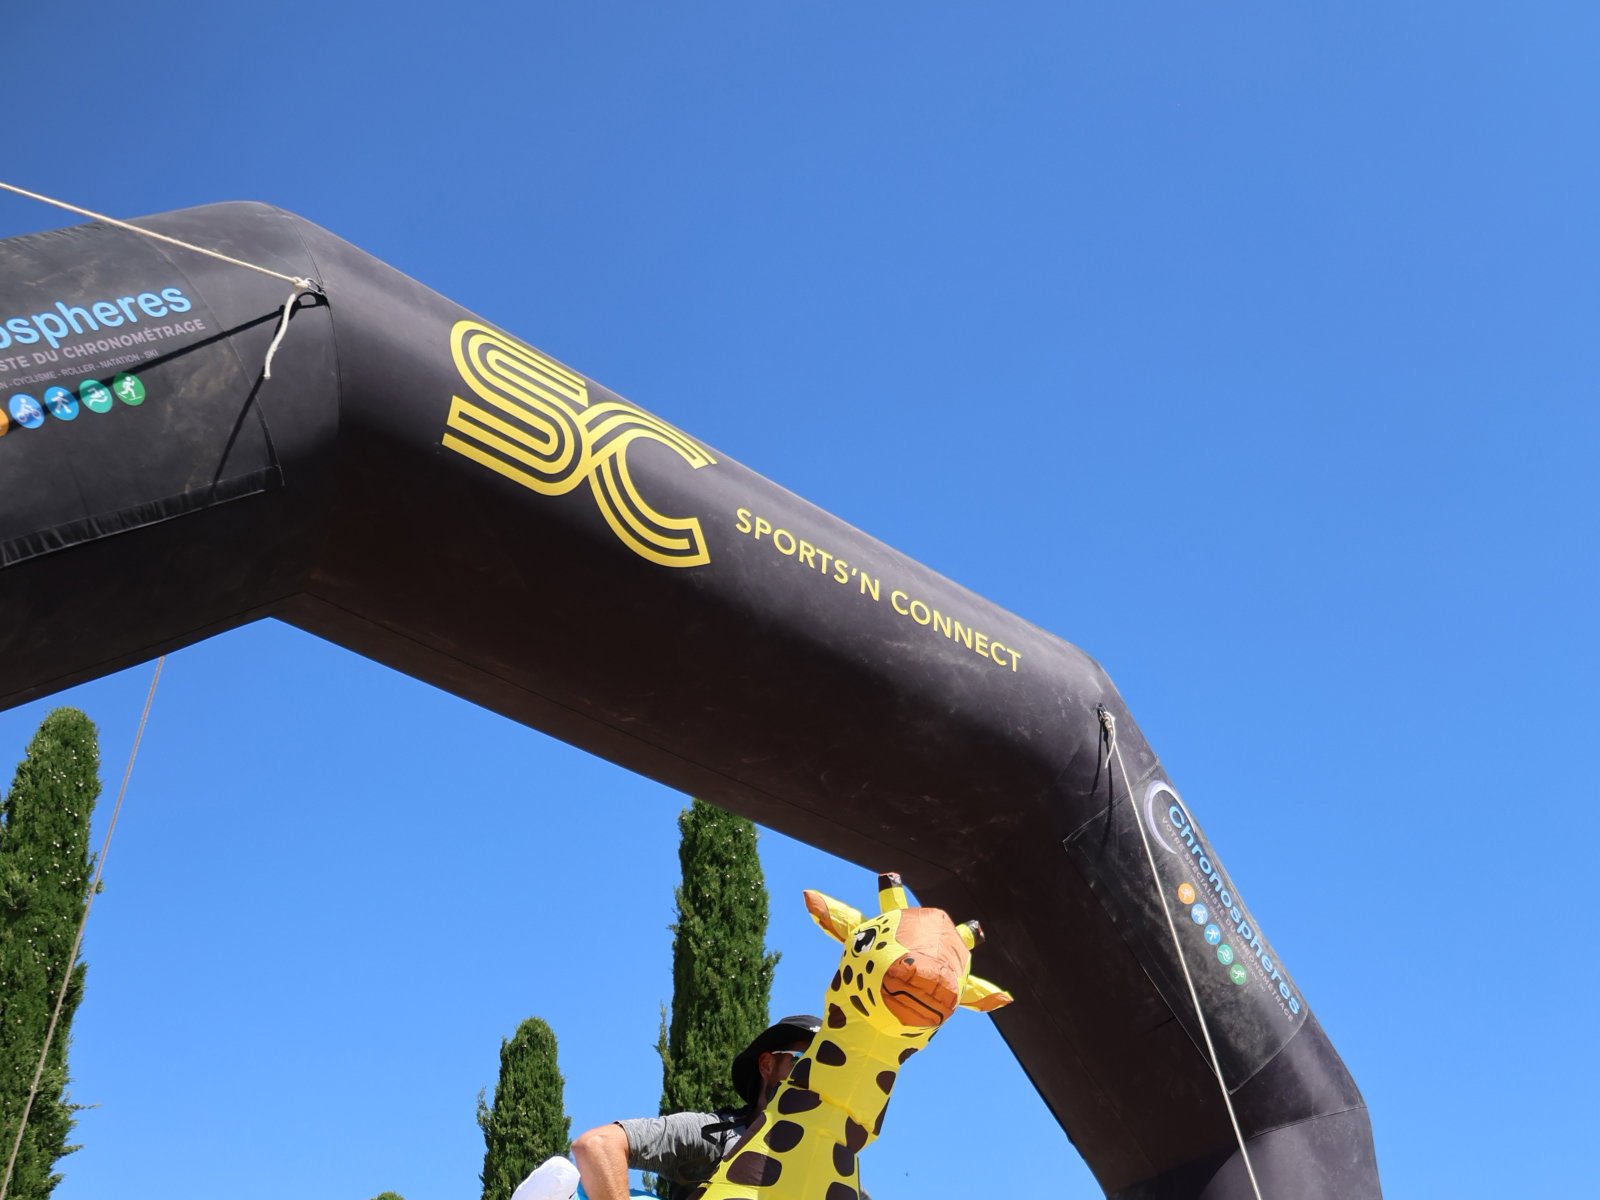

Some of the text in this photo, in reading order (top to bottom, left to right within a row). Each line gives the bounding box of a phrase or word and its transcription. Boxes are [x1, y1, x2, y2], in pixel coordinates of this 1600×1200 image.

[32, 350, 59, 365] DU
[62, 318, 206, 359] CHRONOMÉTRAGE
[62, 363, 97, 377] ROLLER
[99, 354, 141, 368] NATATION
[143, 349, 159, 360] SKI
[891, 590, 1022, 673] CONNECT
[1162, 815, 1186, 852] VOTRE
[1168, 805, 1300, 1015] Chronospheres
